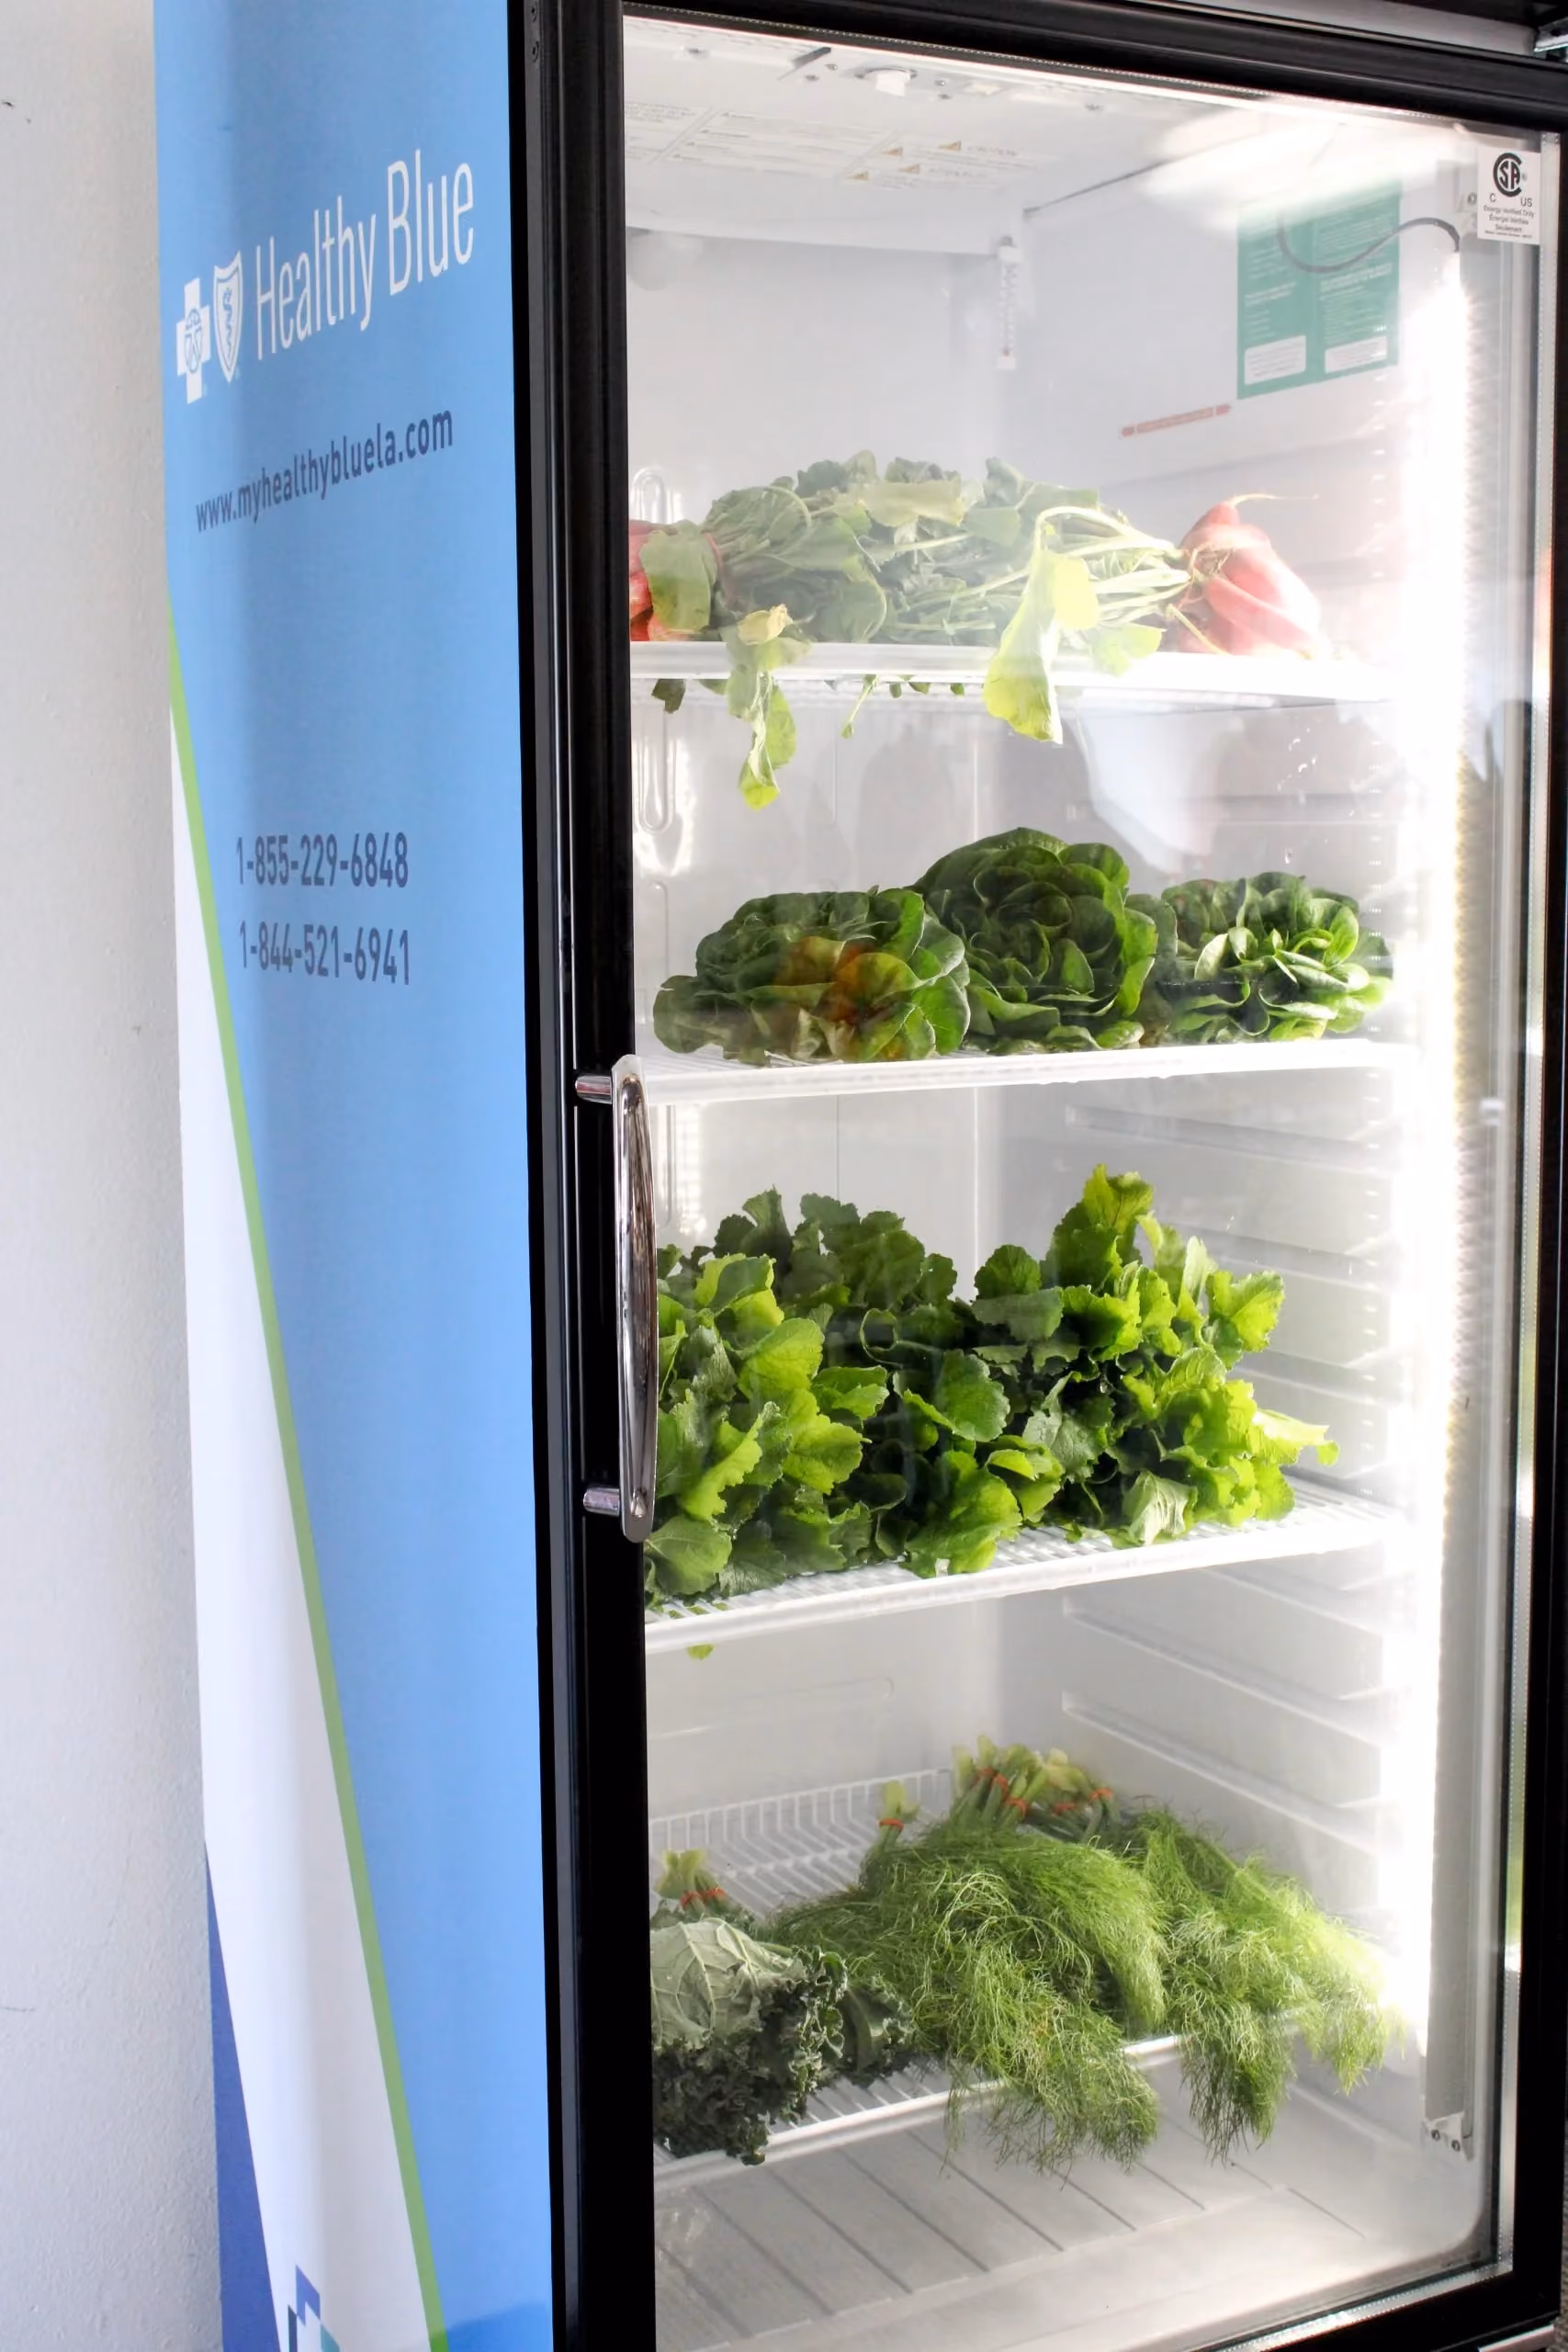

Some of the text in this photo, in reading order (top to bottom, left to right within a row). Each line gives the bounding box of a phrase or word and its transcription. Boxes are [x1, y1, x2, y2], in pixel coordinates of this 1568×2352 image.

[1520, 198, 1533, 208] US
[255, 148, 475, 360] Healthy Blue
[196, 410, 453, 533] www.myhealthybluela.com
[236, 831, 409, 888] 1-855-229-6848
[239, 920, 410, 986] 1-844-521-6941
